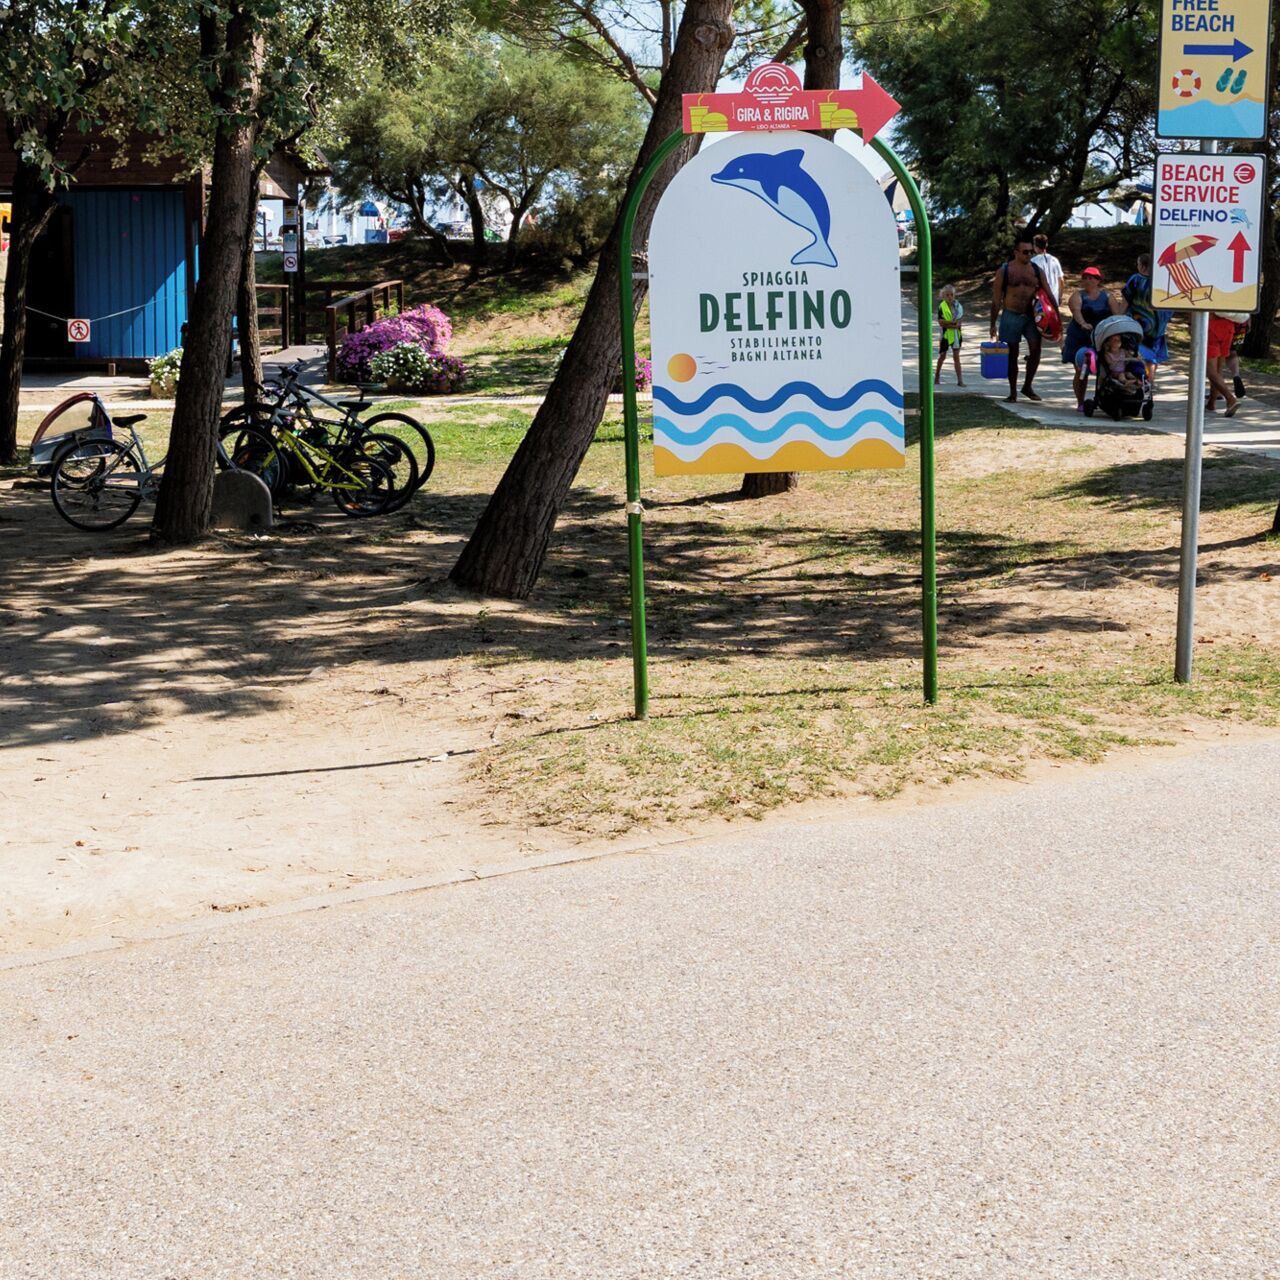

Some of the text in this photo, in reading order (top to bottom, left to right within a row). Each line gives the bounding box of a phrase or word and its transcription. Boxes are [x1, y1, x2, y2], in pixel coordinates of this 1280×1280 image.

[1171, 14, 1235, 32] BEACH
[737, 106, 809, 122] GIRA & RIGIRA
[1161, 164, 1225, 182] BEACH
[1160, 185, 1240, 203] SERVICE
[1159, 208, 1228, 223] DELFINO
[742, 271, 809, 287] SPIAGGIA
[699, 289, 852, 332] DELFINO
[730, 336, 823, 349] STABILIMENTO
[731, 349, 823, 362] BAGNI ALTANEA
